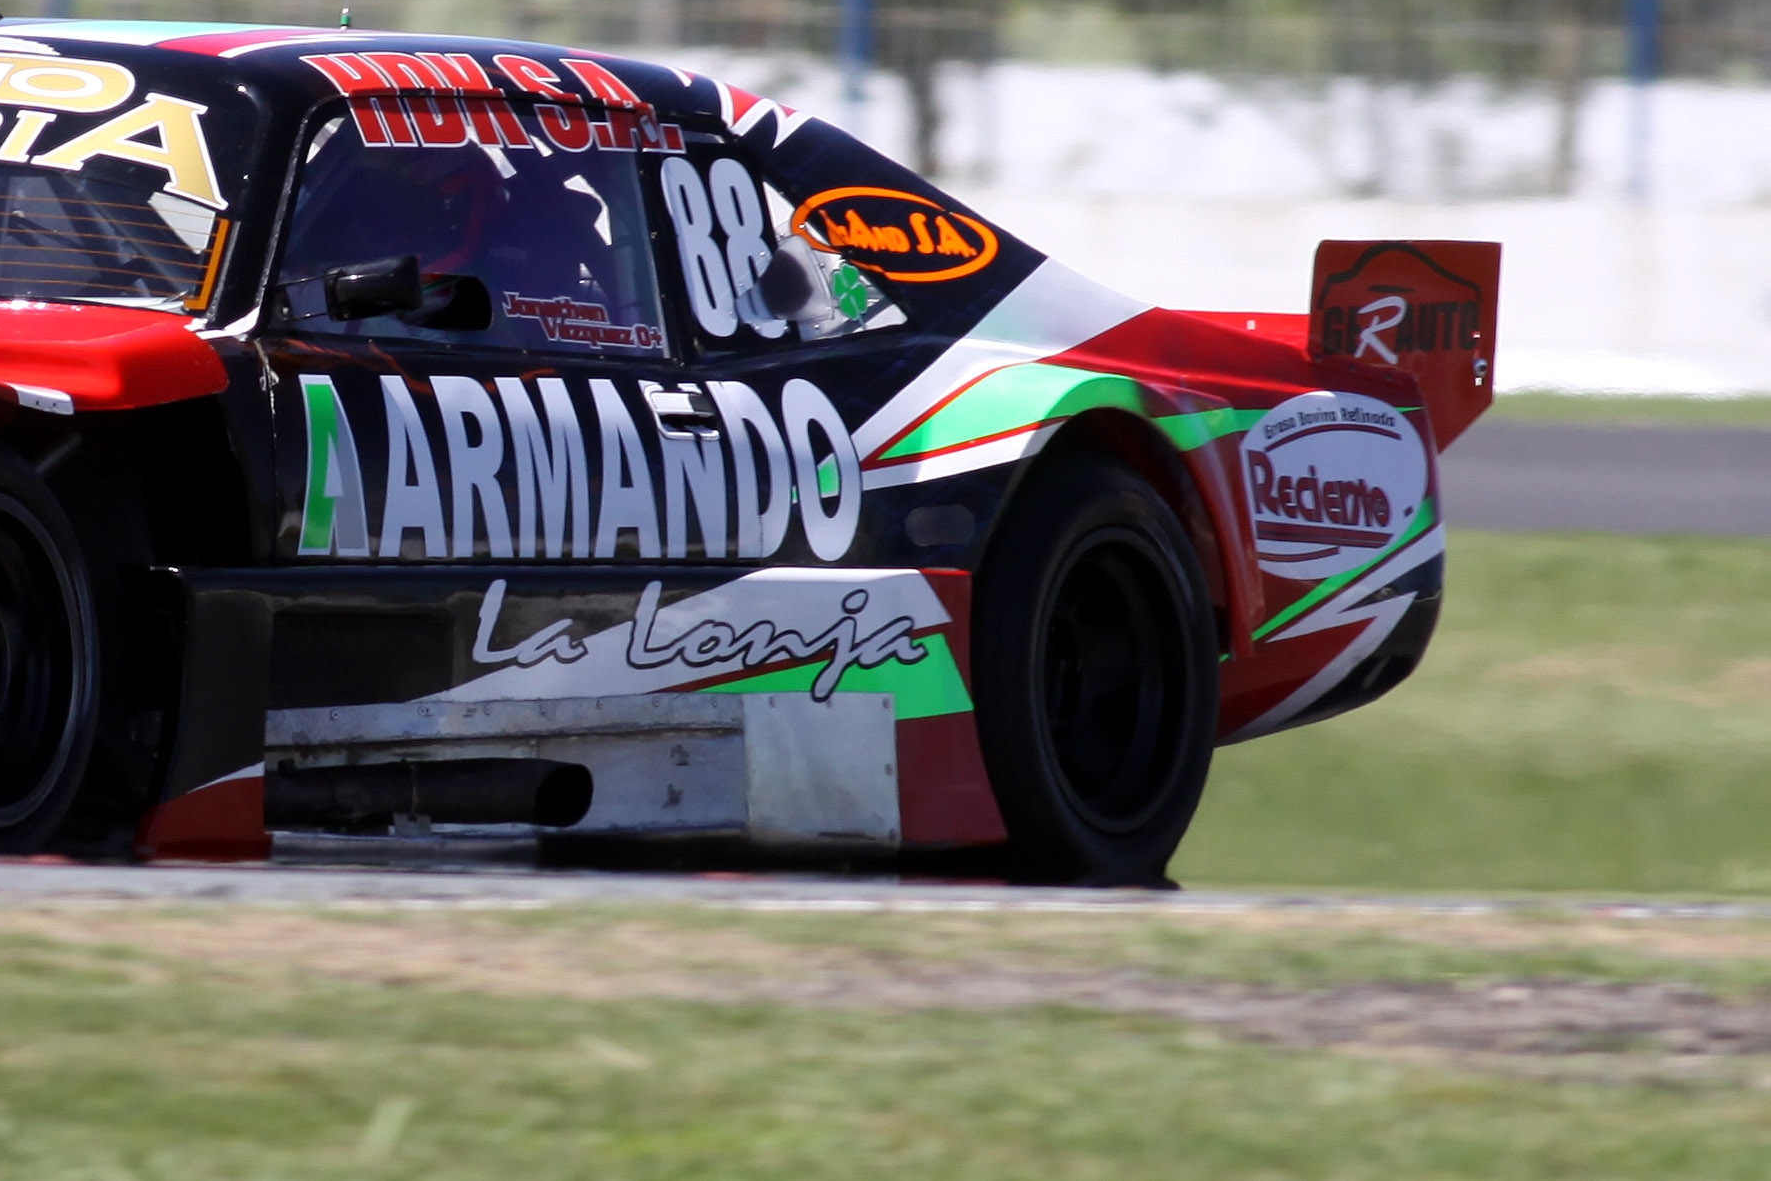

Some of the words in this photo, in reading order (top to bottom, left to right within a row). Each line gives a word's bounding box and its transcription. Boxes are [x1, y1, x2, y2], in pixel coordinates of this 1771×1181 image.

[300, 52, 533, 149] HDK
[661, 156, 787, 339] 88
[379, 374, 862, 561] ARMANDO
[472, 578, 586, 667] La
[626, 579, 929, 703] Lonja
